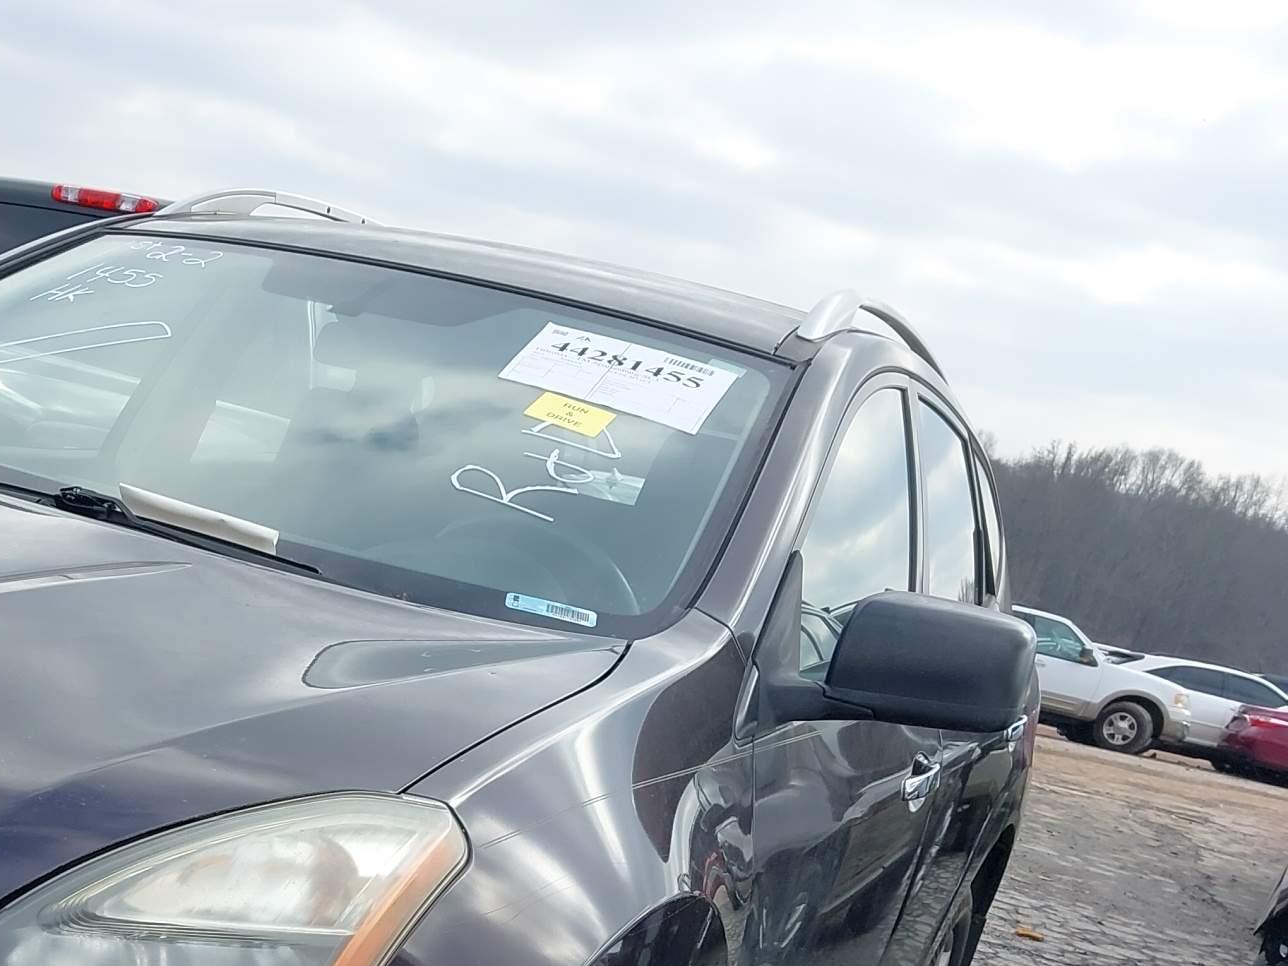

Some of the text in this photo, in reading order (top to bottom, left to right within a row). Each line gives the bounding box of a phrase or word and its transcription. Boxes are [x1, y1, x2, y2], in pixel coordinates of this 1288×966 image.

[67, 262, 163, 288] 1455
[550, 341, 705, 390] 44281455
[562, 401, 590, 415] RUN
[546, 411, 583, 428] DRIVE
